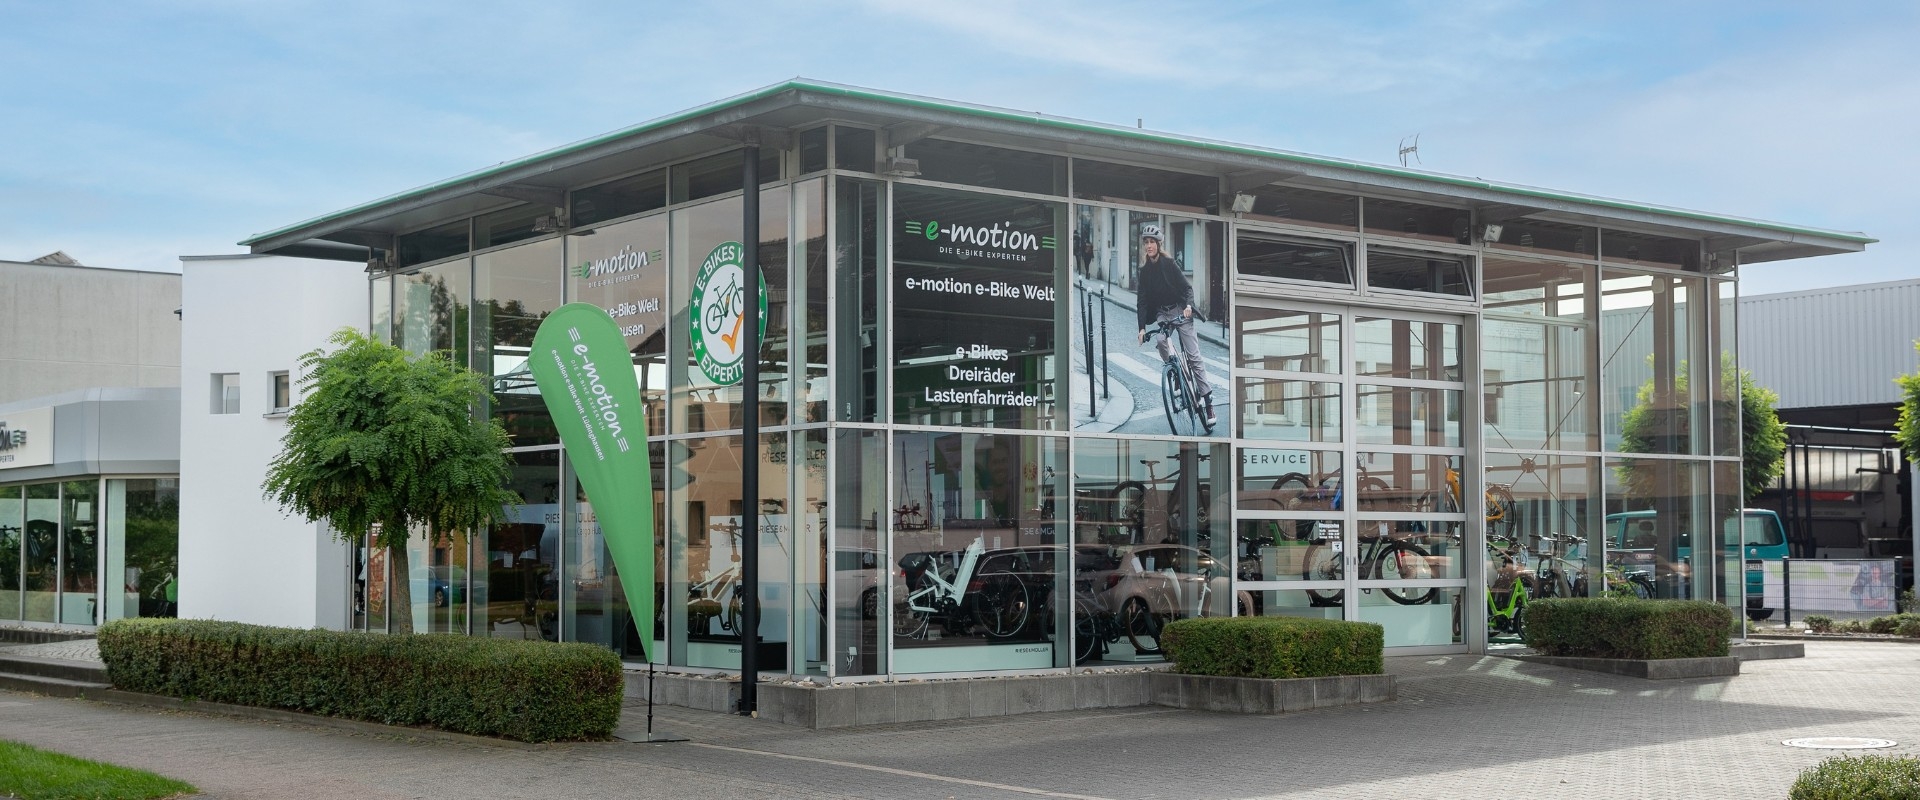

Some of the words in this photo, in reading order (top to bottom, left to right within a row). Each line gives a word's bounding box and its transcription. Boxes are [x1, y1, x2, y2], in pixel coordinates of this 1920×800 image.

[925, 221, 1039, 251] e-motion
[581, 244, 649, 280] e-motion
[939, 246, 953, 255] DIE
[956, 248, 984, 258] E-BIKE
[986, 251, 1027, 262] EXPERTEN
[696, 245, 735, 292] E-BIKES
[905, 276, 972, 295] e-motion
[975, 281, 1020, 299] e-Bike
[1022, 284, 1055, 302] Welt
[609, 301, 637, 319] e-Bike
[637, 297, 660, 313] Welt
[955, 344, 1009, 361] e-Bikes
[949, 365, 1016, 384] Dreiräder
[573, 343, 623, 439] e-motion
[925, 386, 1039, 407] Lastenfahrräder
[551, 349, 569, 382] e-motion
[565, 377, 578, 401] e-Bike
[574, 398, 585, 415] Welt
[581, 415, 605, 462] Lüdinghausen
[1243, 454, 1307, 464] SERVICE
